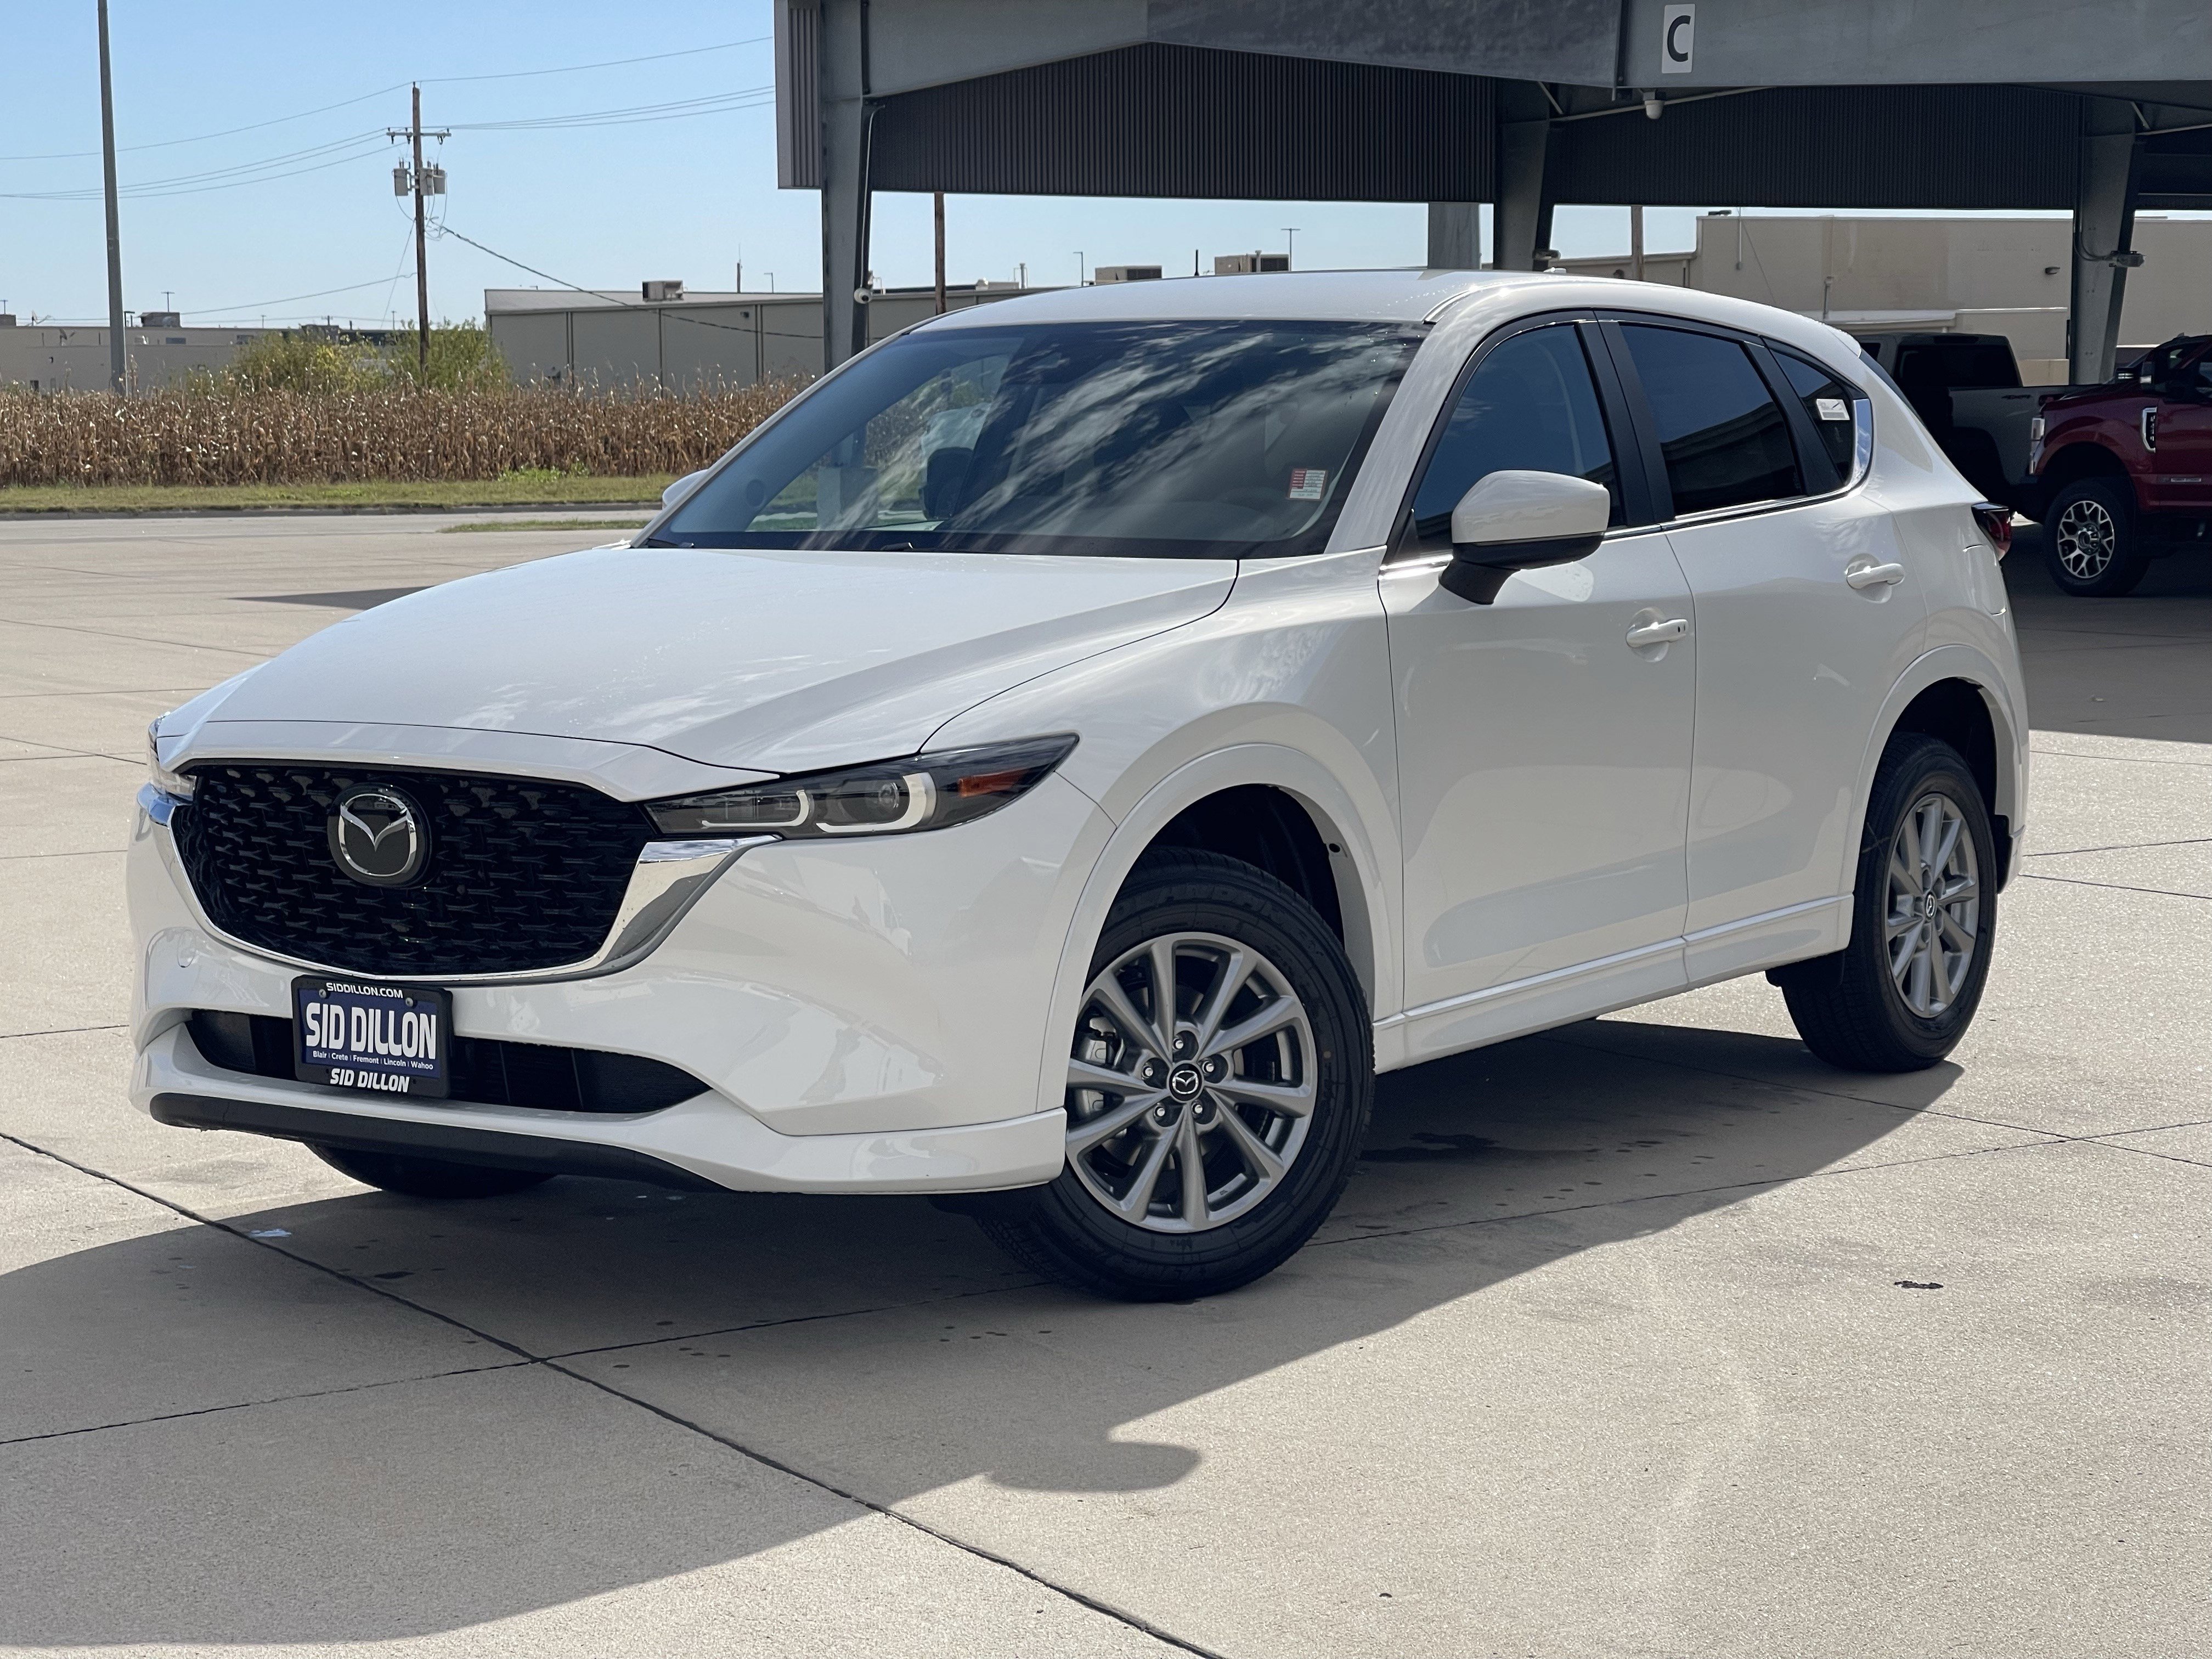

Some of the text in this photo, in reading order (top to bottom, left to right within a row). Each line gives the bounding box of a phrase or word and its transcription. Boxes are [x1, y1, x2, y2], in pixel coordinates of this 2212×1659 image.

[1667, 15, 1691, 62] C
[326, 982, 403, 998] SIDDILLON.COM
[306, 1002, 436, 1059] SID DILLON
[313, 1050, 433, 1070] Blair Crete Fremont Lincoln Wahoo
[330, 1068, 410, 1093] SID DILLON
